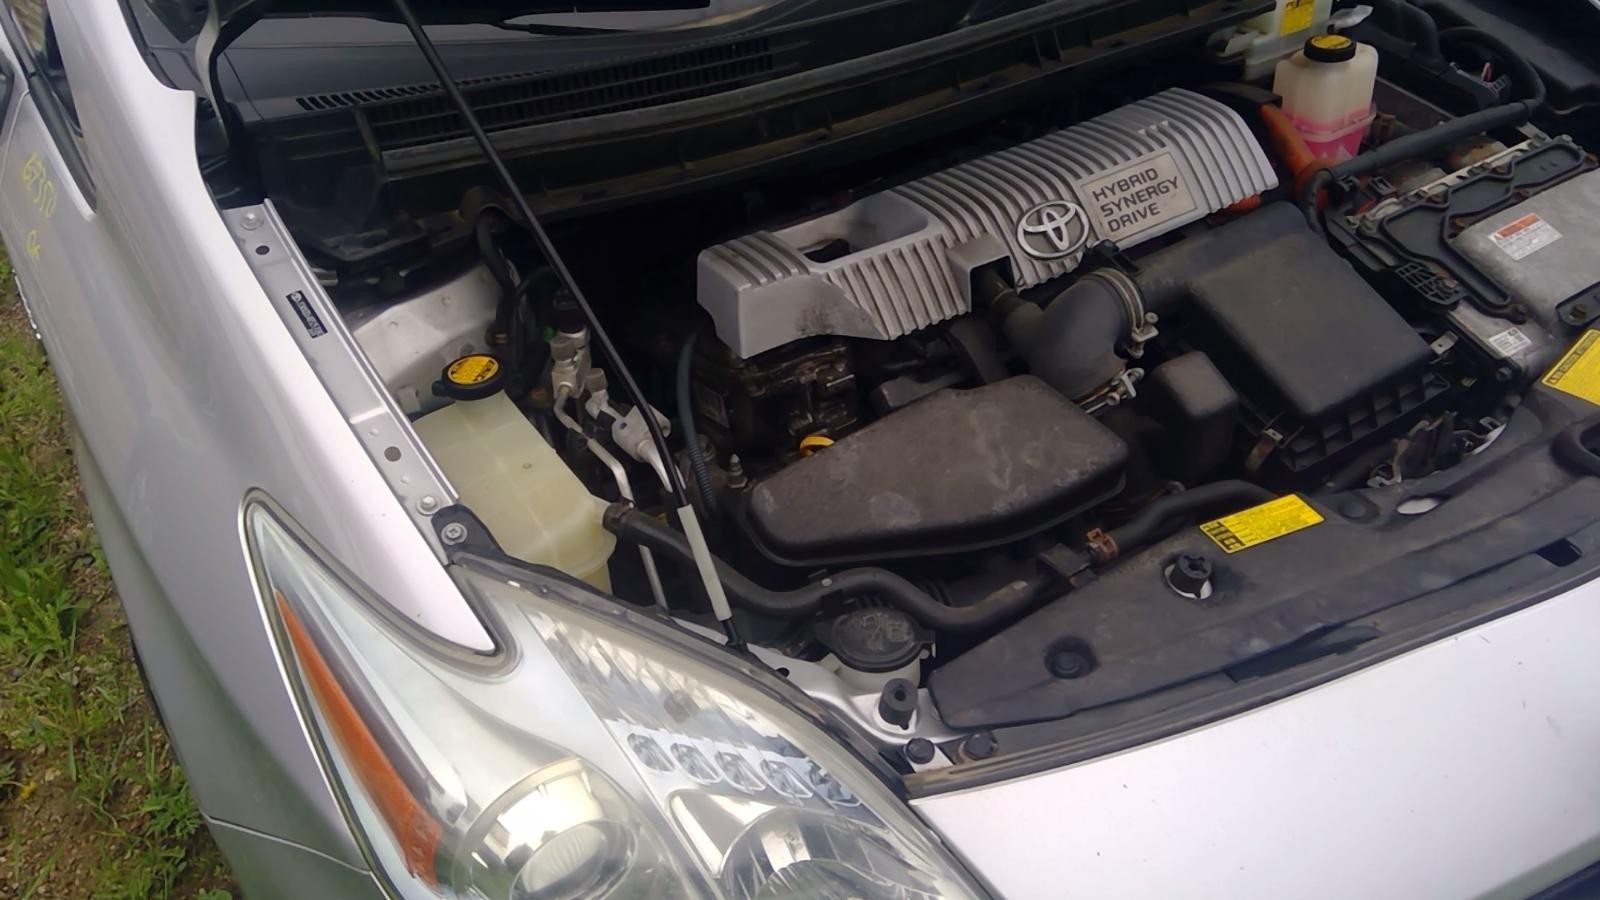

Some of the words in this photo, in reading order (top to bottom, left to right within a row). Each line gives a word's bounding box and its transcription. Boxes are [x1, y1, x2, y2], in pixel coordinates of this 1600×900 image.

[1092, 168, 1159, 202] HYBRID
[1100, 176, 1178, 217] SYNERGY
[1107, 202, 1161, 233] DRIVE
